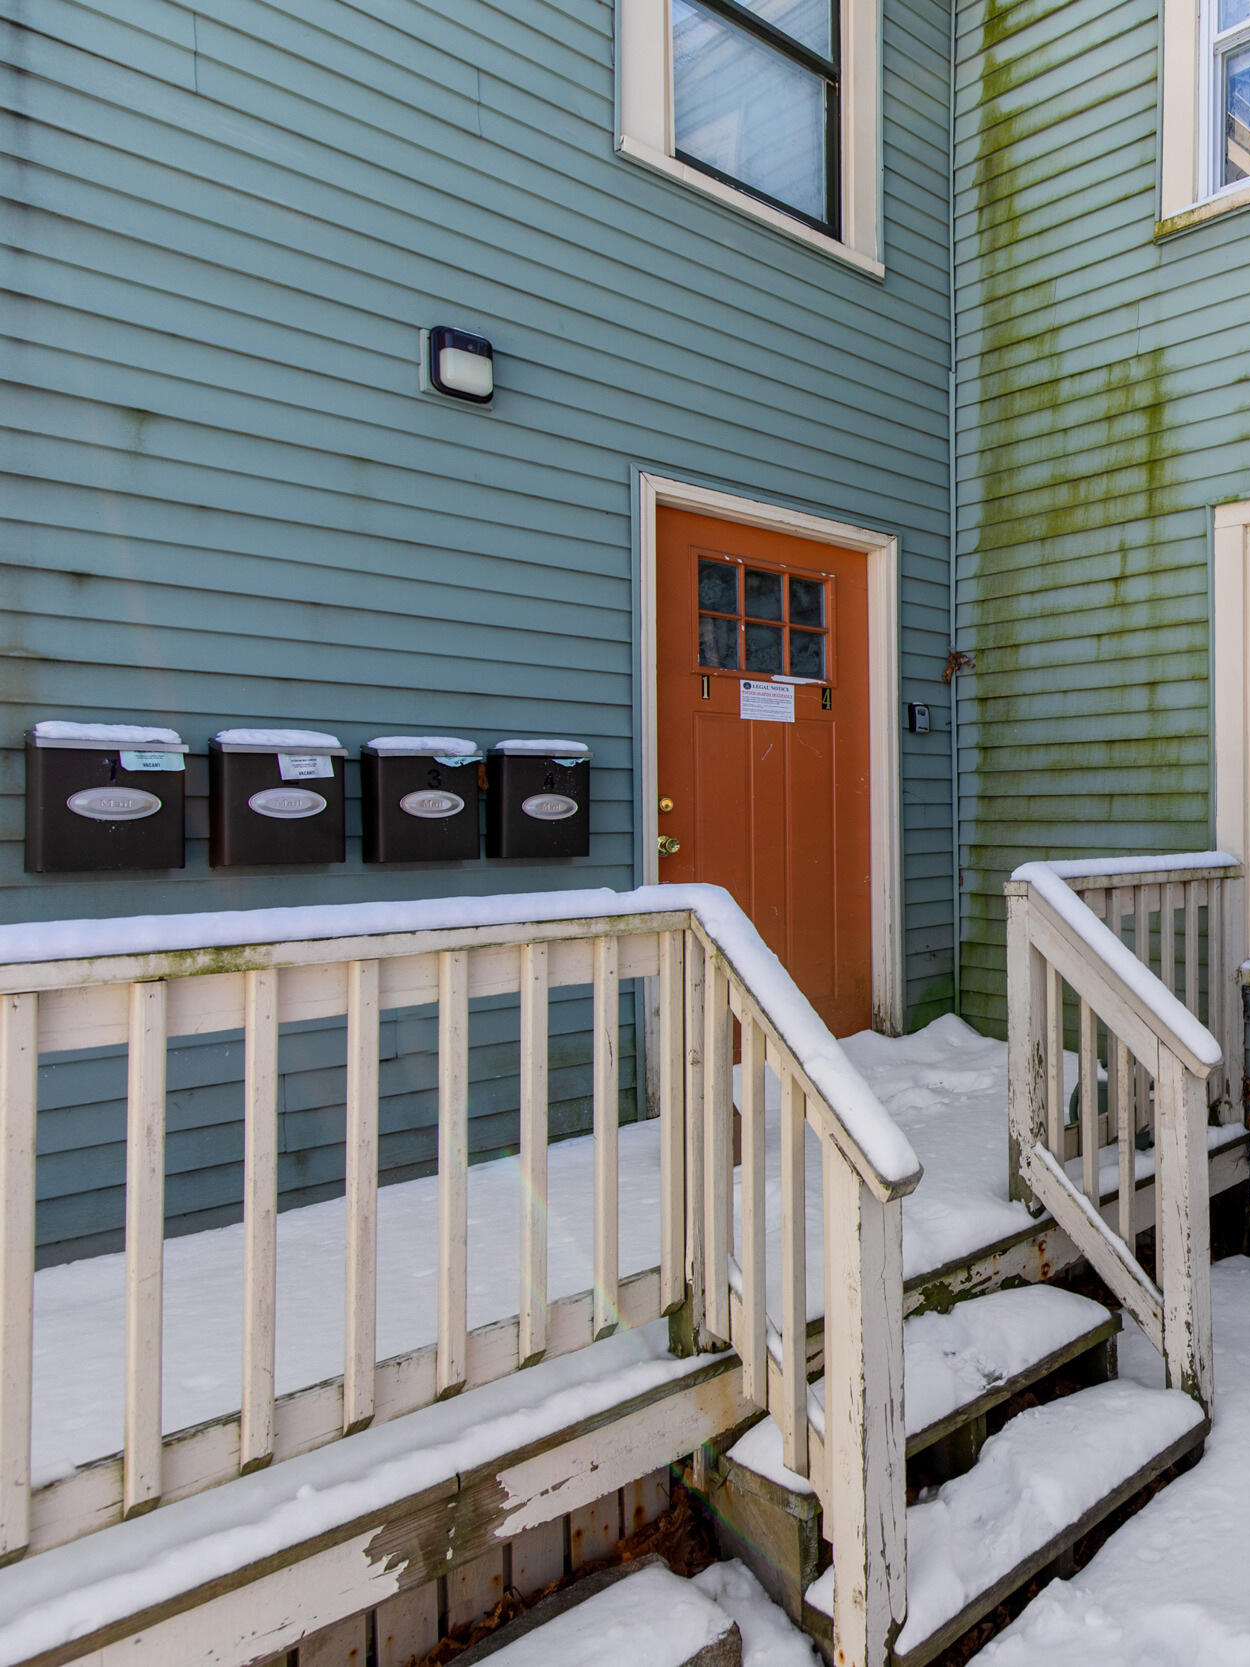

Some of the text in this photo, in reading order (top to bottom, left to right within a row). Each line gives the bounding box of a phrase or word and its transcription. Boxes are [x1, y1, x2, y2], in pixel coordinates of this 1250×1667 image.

[703, 676, 709, 699] 1
[822, 688, 832, 709] 4
[427, 768, 442, 789] 3
[100, 799, 133, 809] Mail
[422, 799, 444, 809] Mail
[542, 802, 561, 811] Mail
